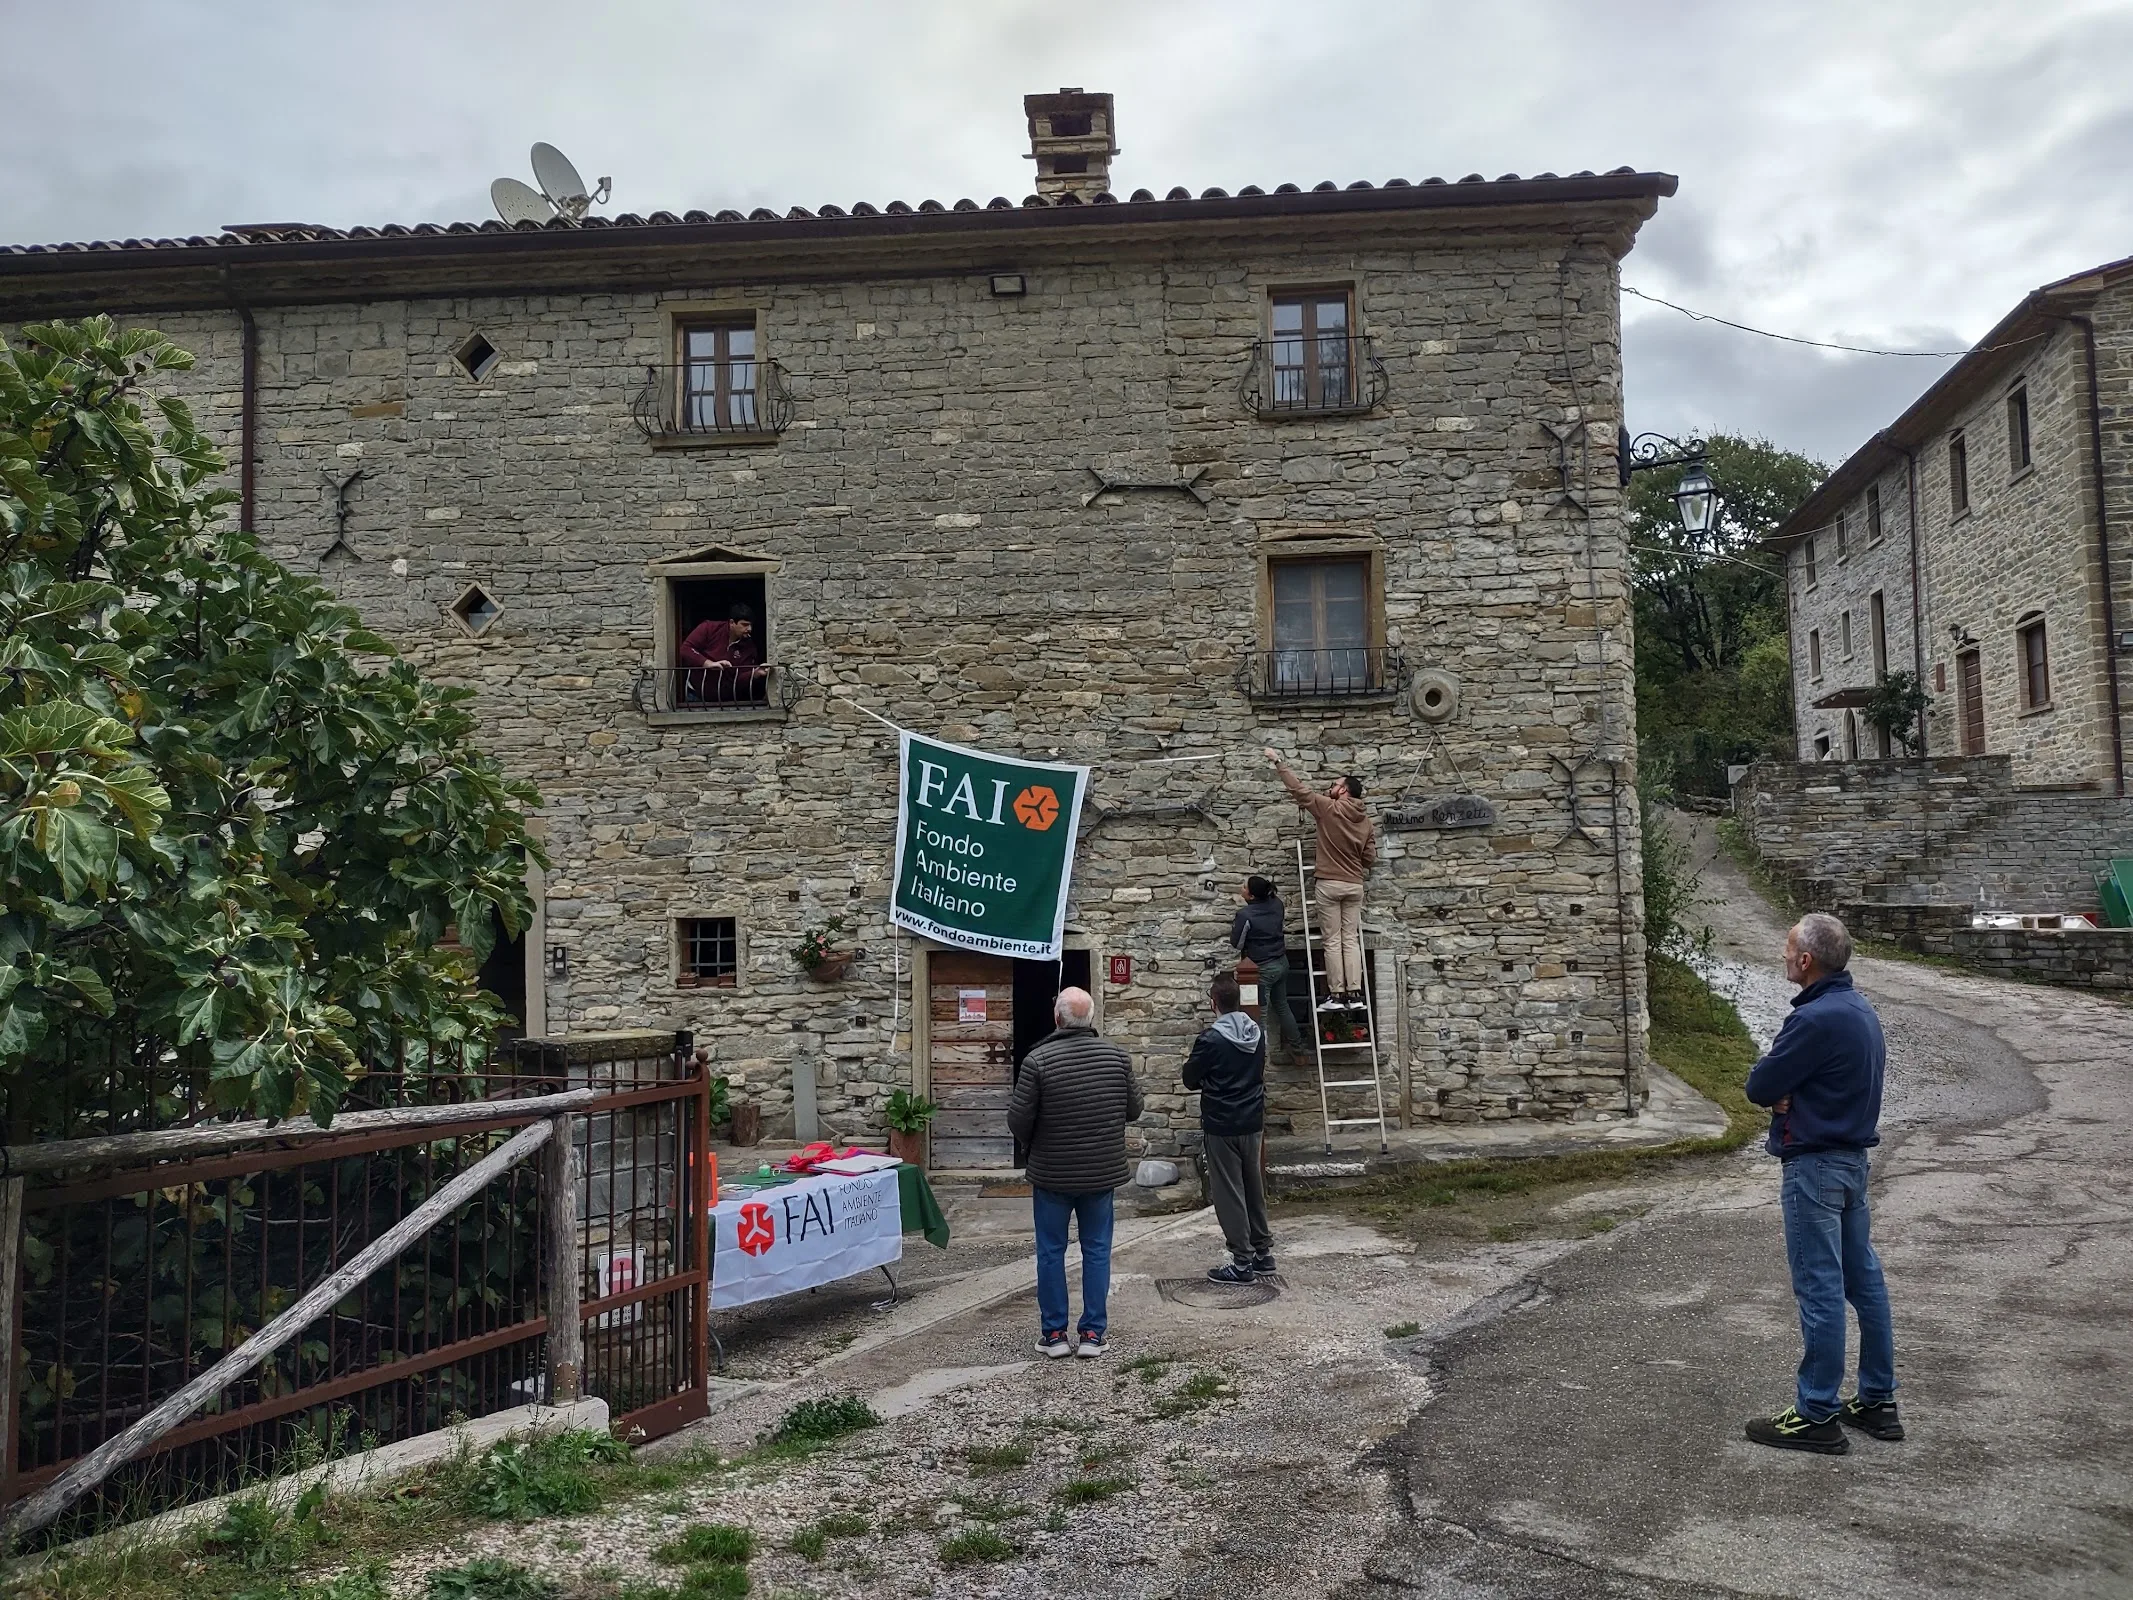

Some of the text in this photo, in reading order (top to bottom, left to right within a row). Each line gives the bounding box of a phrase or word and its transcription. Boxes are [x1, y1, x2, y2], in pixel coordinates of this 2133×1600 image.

[915, 759, 1011, 826] FAI
[916, 819, 985, 858] Fondo
[916, 849, 1018, 893] Ambiente
[910, 874, 986, 919] Italiano
[895, 909, 1052, 955] www.fondoambiente.it
[838, 1178, 874, 1196] FONDO
[842, 1190, 882, 1213] AMBIENTE
[782, 1188, 835, 1245] FAI
[844, 1208, 878, 1230] ITALIANO
